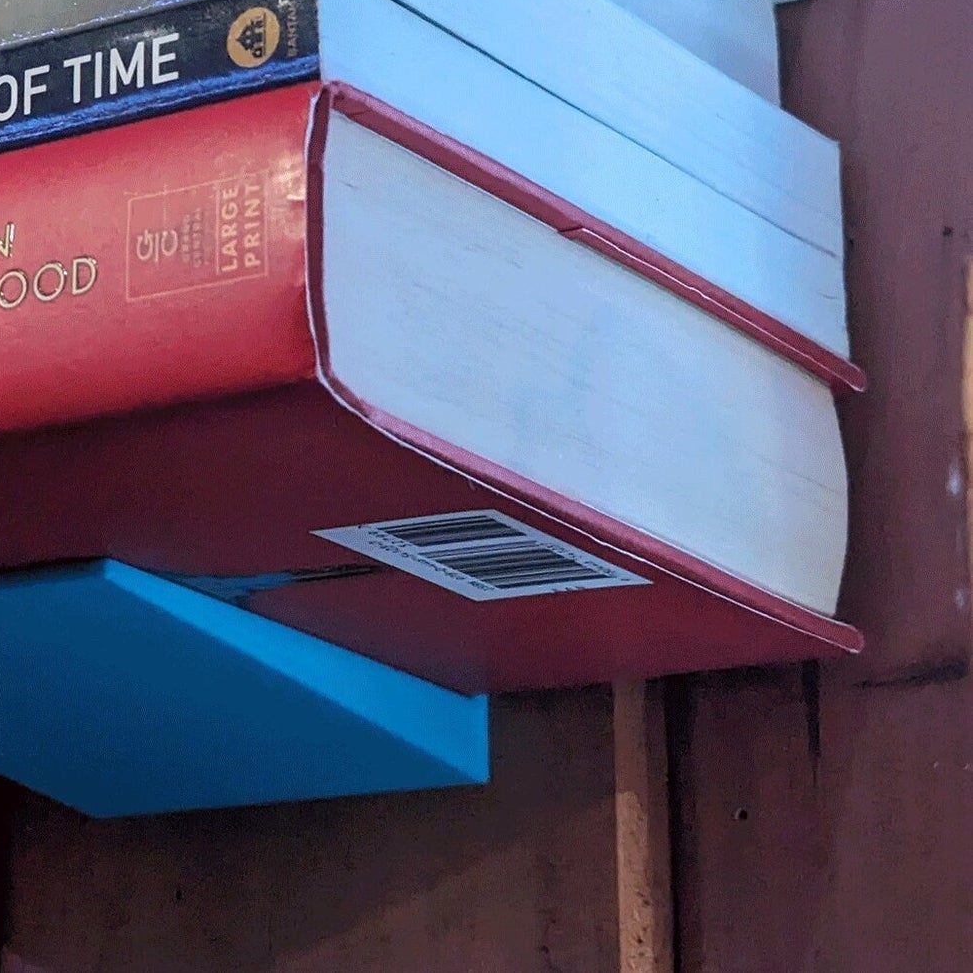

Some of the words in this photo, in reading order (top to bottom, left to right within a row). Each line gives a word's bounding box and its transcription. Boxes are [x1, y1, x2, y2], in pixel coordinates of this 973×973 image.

[62, 31, 181, 105] TIME
[220, 184, 239, 273] LARGE
[243, 177, 262, 269] PRINT
